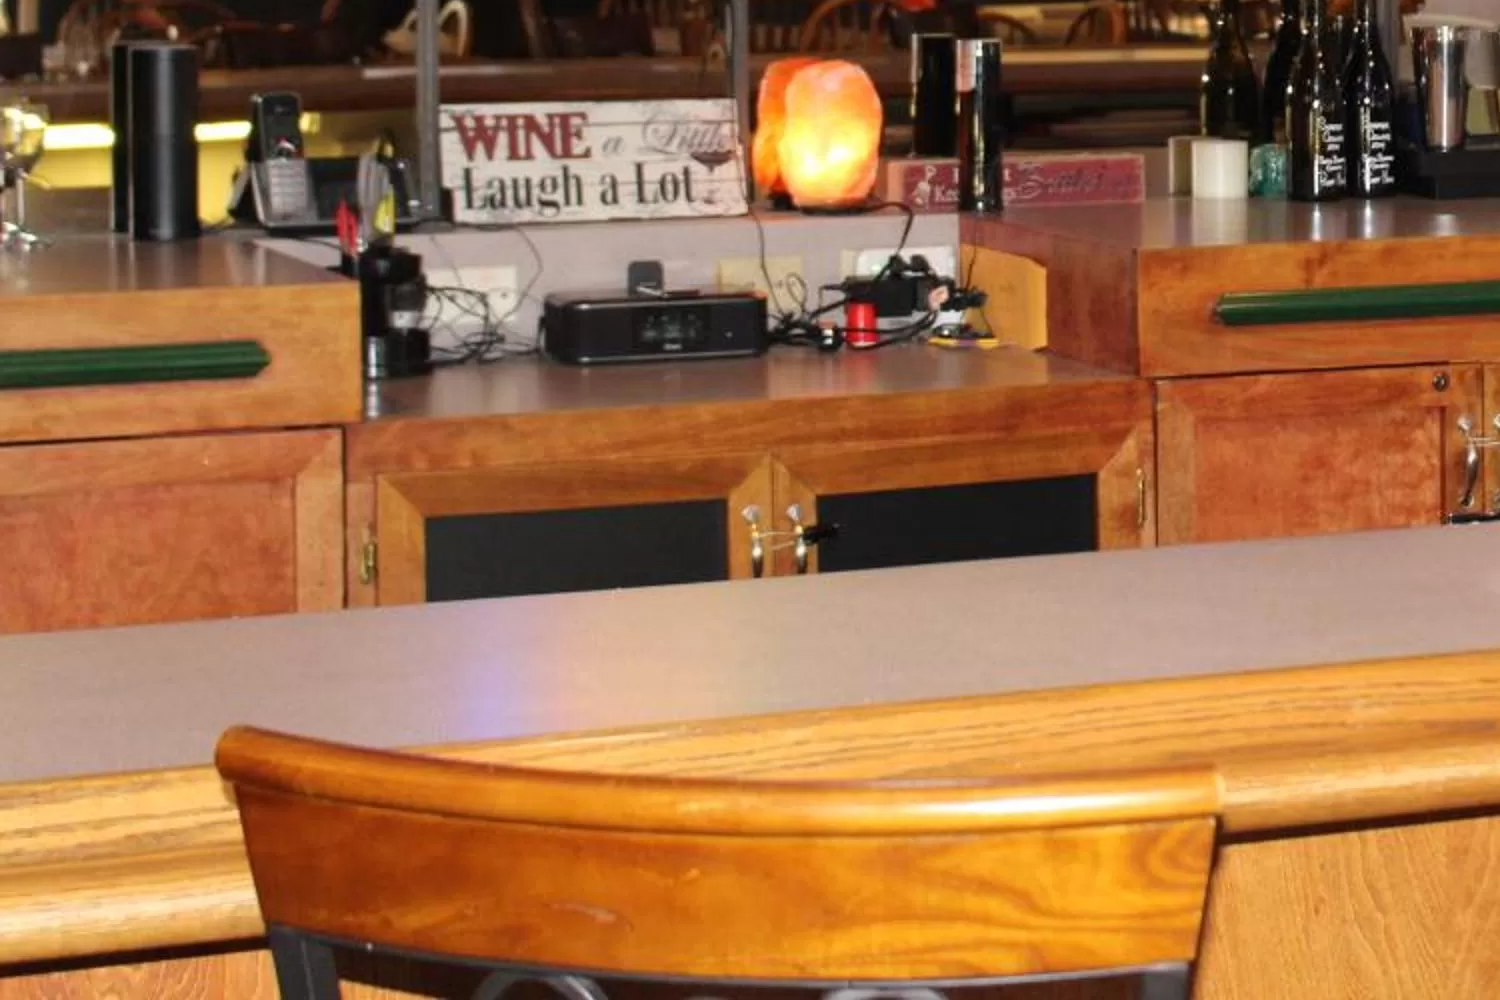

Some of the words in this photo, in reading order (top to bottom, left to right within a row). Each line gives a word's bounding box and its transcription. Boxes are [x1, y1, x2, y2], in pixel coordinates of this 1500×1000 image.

[454, 112, 591, 162] WINE
[602, 136, 624, 155] a
[463, 165, 584, 218] Laugh
[600, 172, 620, 206] a
[635, 161, 698, 206] Lot
